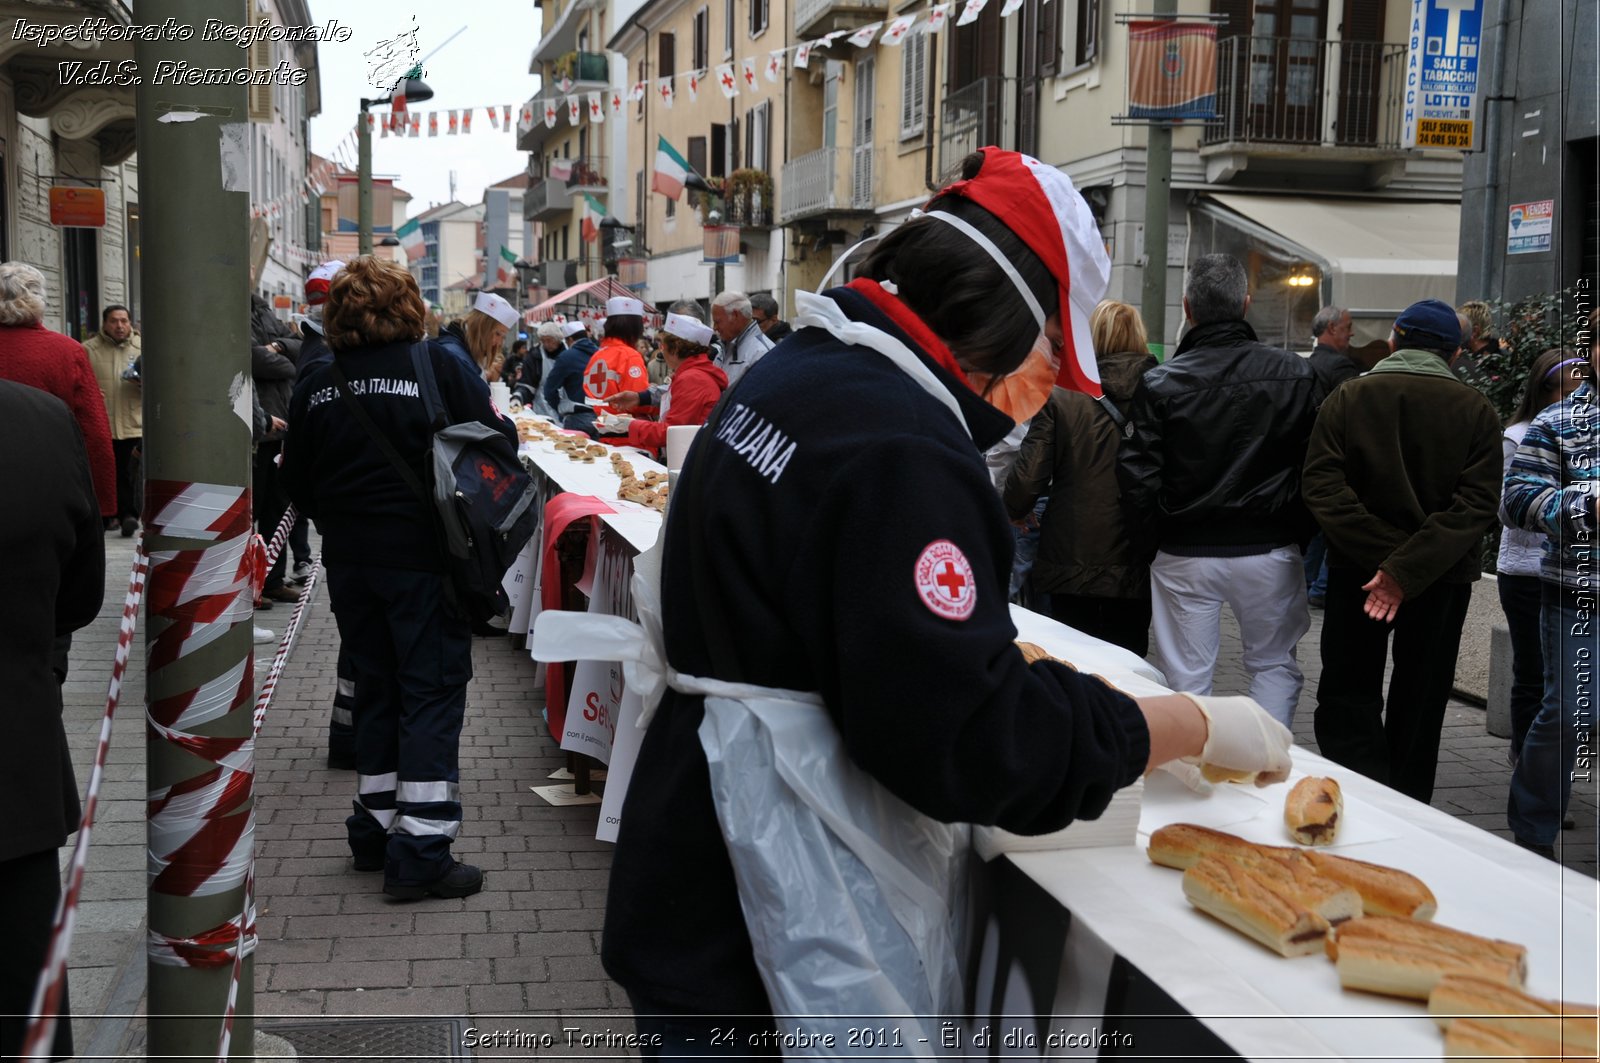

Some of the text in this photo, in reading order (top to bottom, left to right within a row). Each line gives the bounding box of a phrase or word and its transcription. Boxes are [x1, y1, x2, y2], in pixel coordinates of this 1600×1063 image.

[1405, 0, 1420, 140] TABACCHI
[1433, 57, 1467, 70] SALI E
[1424, 69, 1475, 83] TABACCHI
[1448, 84, 1475, 93] BOLLATI
[1425, 93, 1470, 107] LOTTO
[1421, 121, 1468, 134] SELF SERVICE
[1419, 133, 1469, 146] 24 ORE SU 24
[368, 378, 420, 398] ITALIANA
